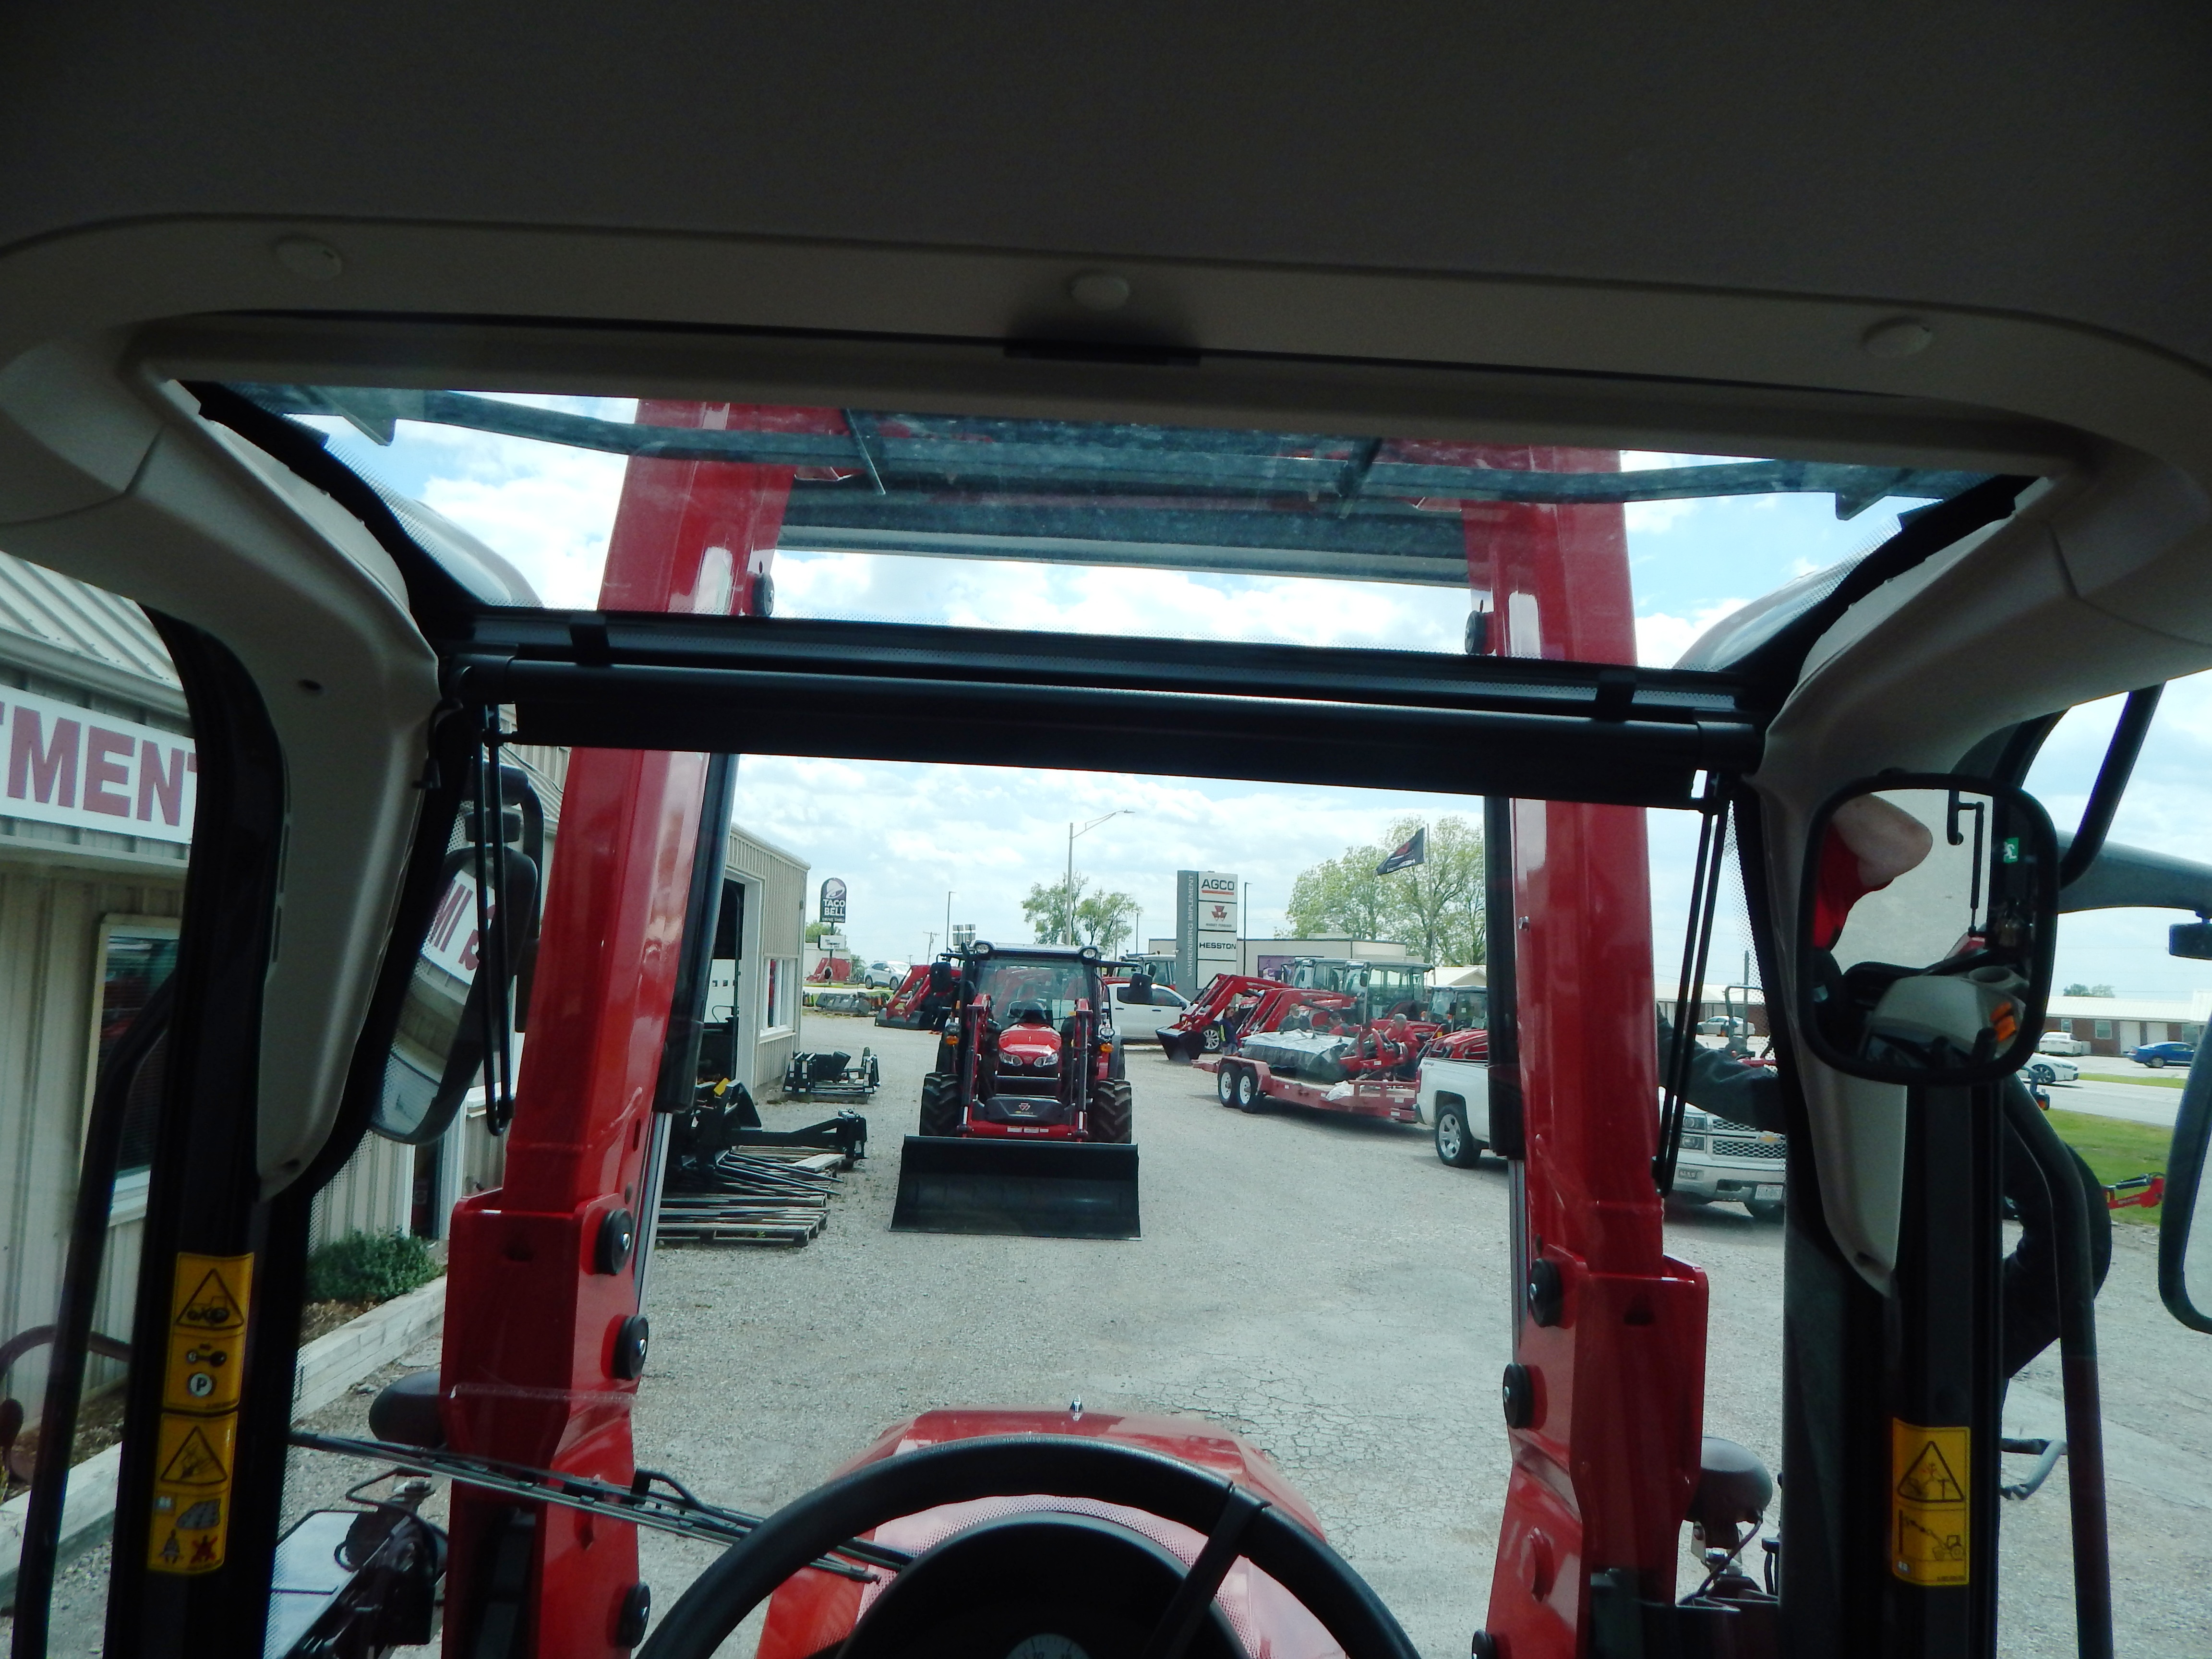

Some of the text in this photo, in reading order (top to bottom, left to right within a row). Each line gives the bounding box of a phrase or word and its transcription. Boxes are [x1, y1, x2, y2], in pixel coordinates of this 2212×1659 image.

[1201, 879, 1235, 891] AGCO
[823, 899, 845, 907] TACO
[824, 907, 845, 916] BELL
[196, 1377, 207, 1392] P
